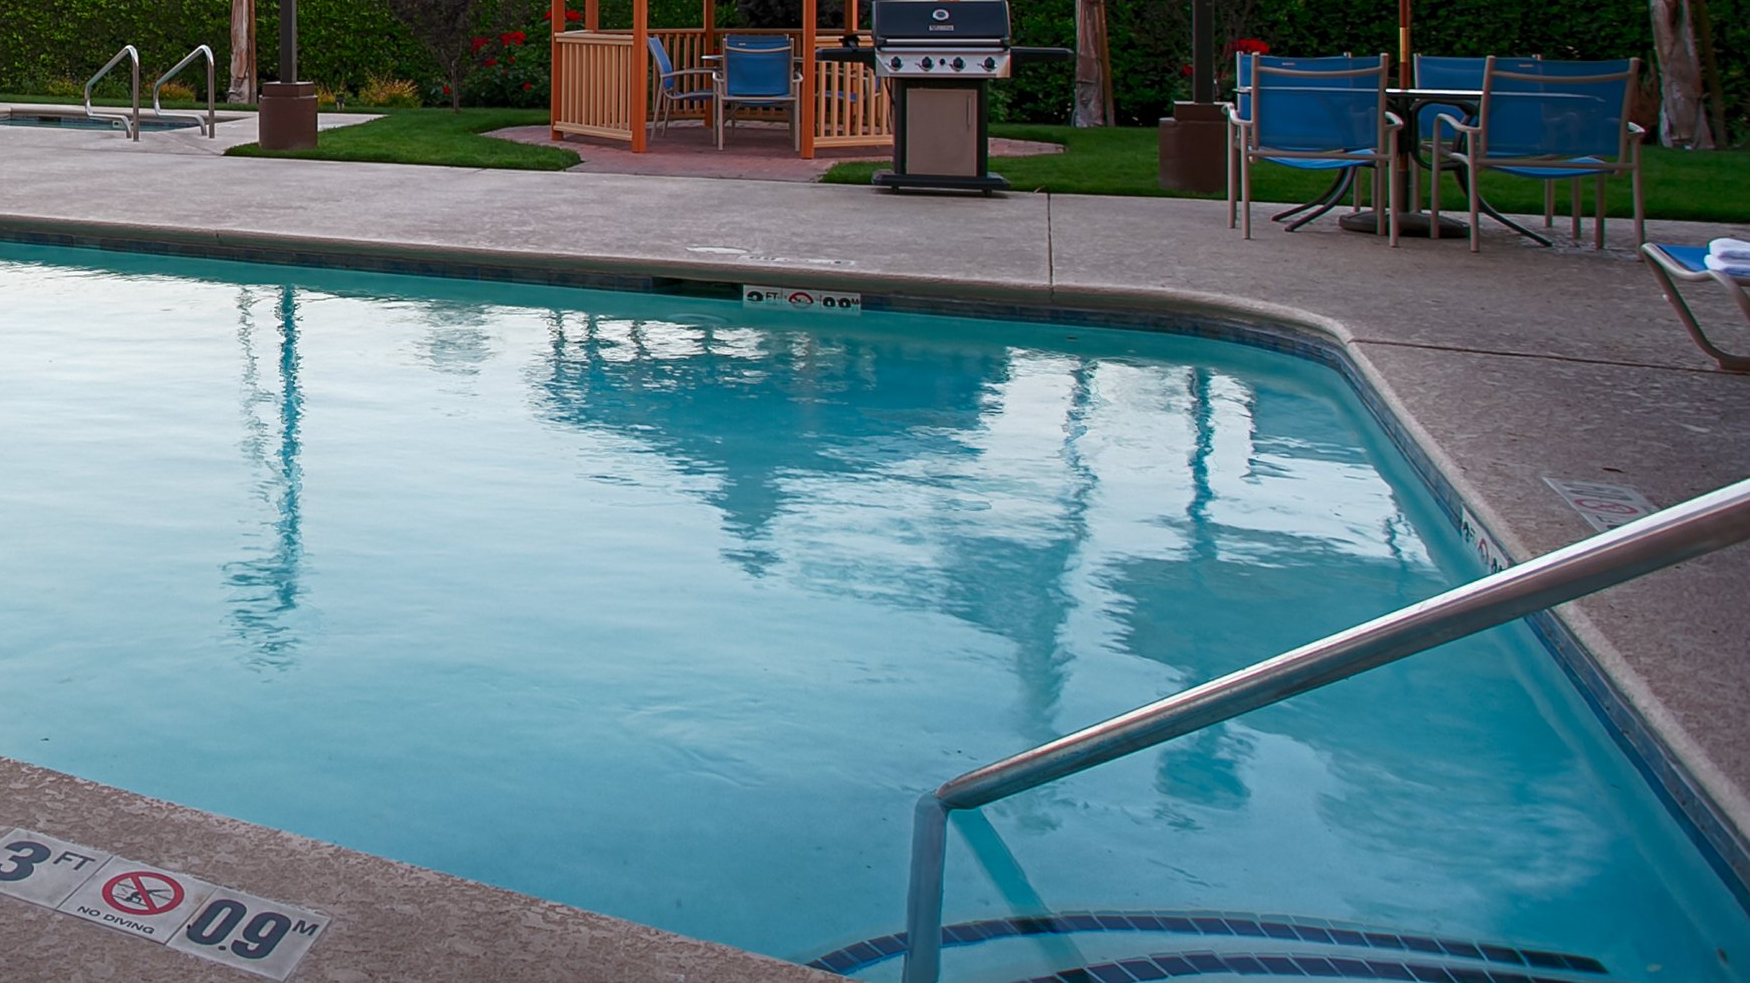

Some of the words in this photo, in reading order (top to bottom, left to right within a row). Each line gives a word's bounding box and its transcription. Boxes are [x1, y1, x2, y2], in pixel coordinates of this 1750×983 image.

[52, 850, 96, 872] FT
[76, 905, 101, 918] NO
[101, 912, 156, 936] DIVING
